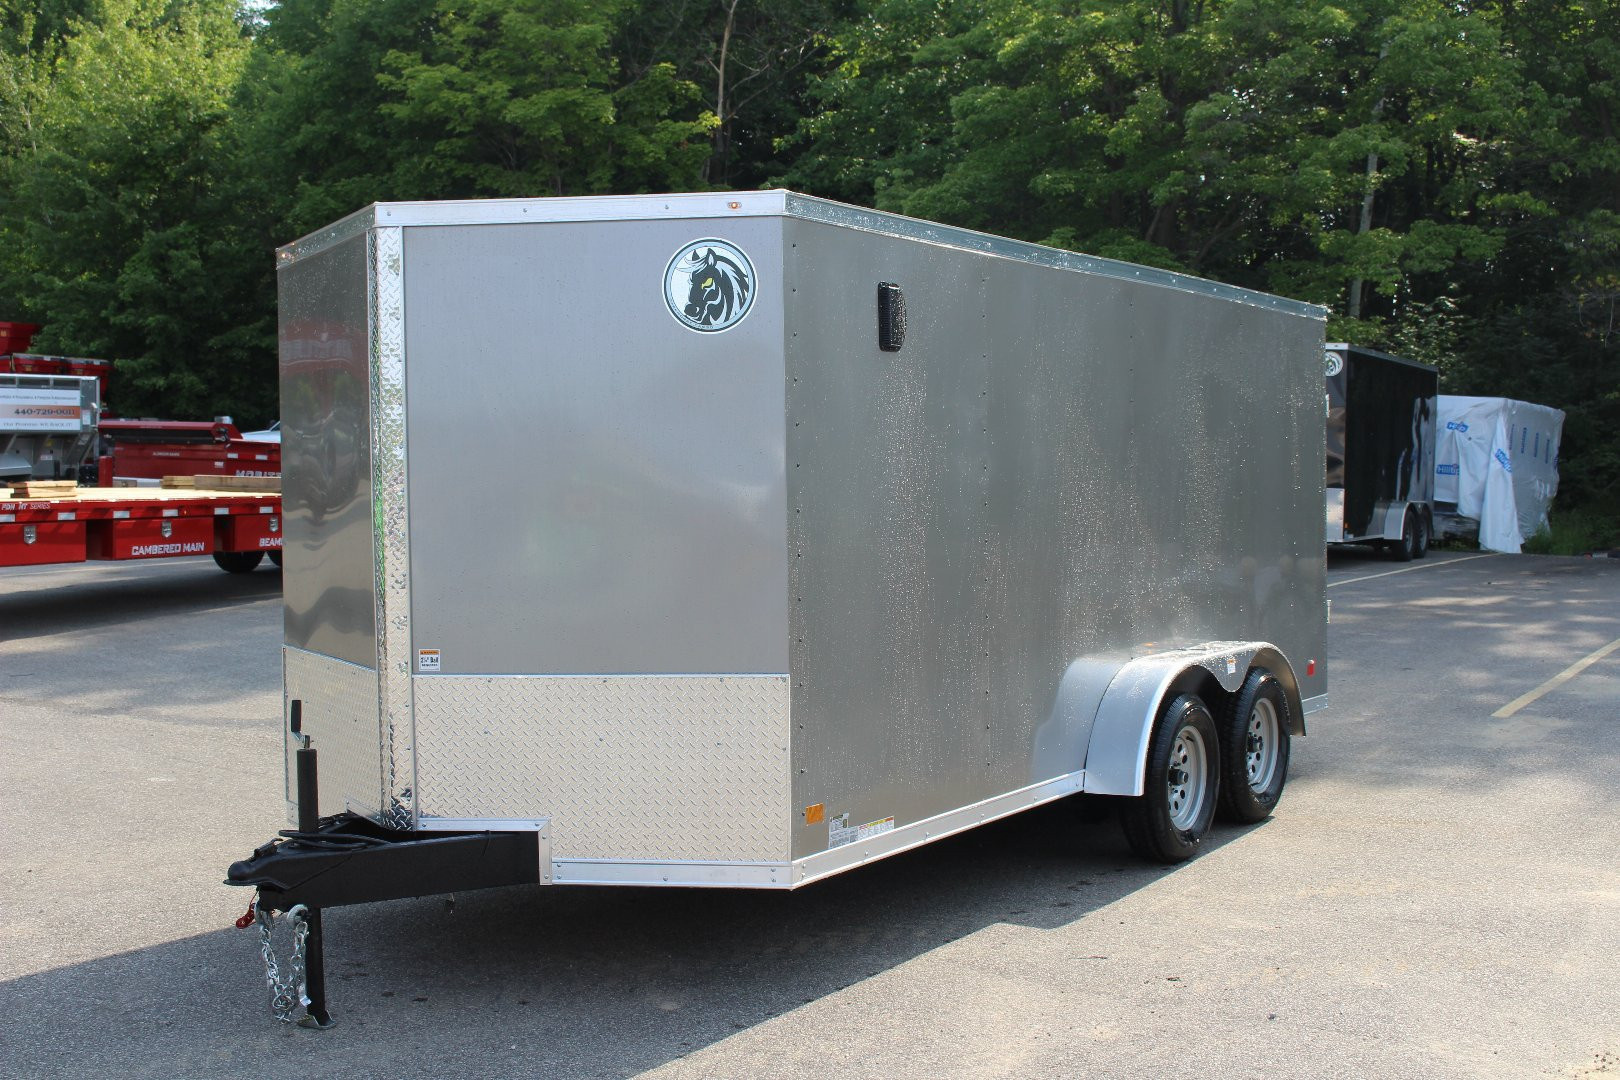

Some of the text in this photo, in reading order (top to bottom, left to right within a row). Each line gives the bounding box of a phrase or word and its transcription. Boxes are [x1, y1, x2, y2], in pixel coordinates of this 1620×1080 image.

[259, 537, 282, 547] BEAM
[131, 541, 205, 556] CAMBERED MAIN
